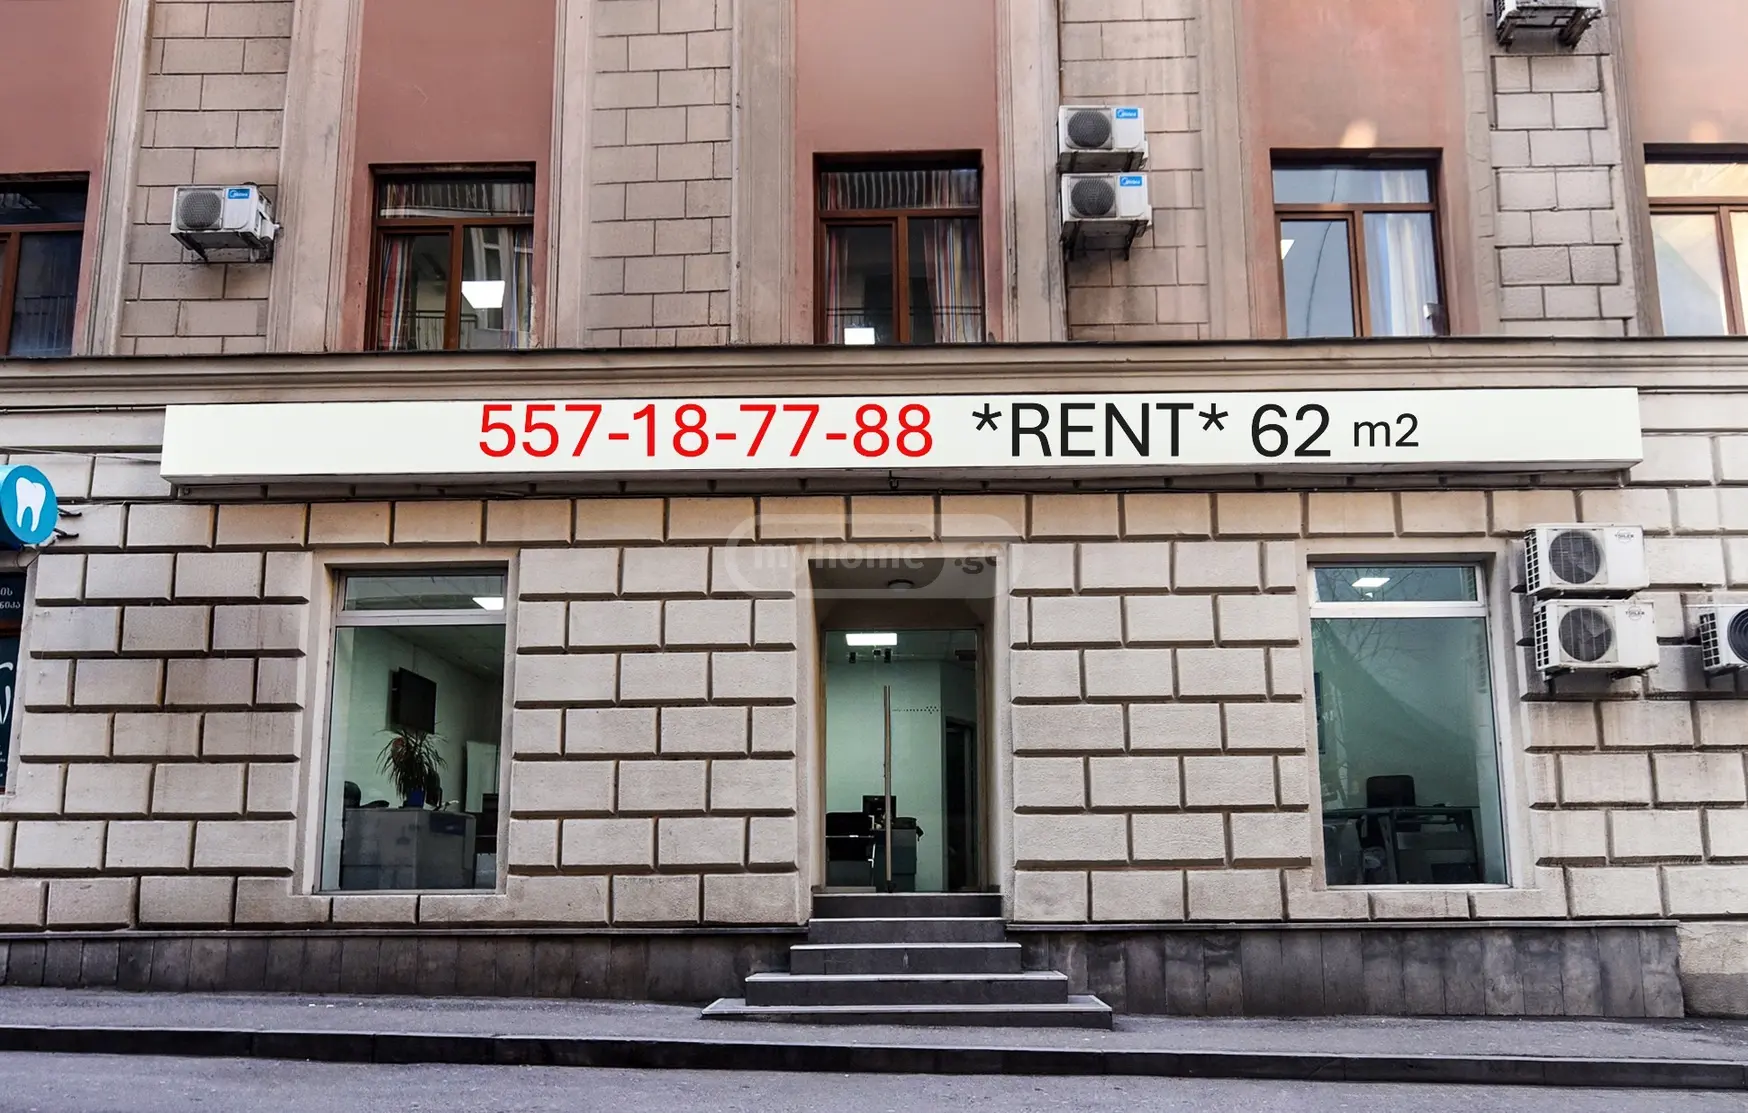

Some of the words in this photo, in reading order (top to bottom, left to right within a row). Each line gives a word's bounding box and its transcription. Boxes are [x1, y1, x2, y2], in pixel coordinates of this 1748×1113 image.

[479, 403, 933, 458] 557-18-77-88
[1252, 403, 1331, 458] 62
[1354, 412, 1419, 447] m2
